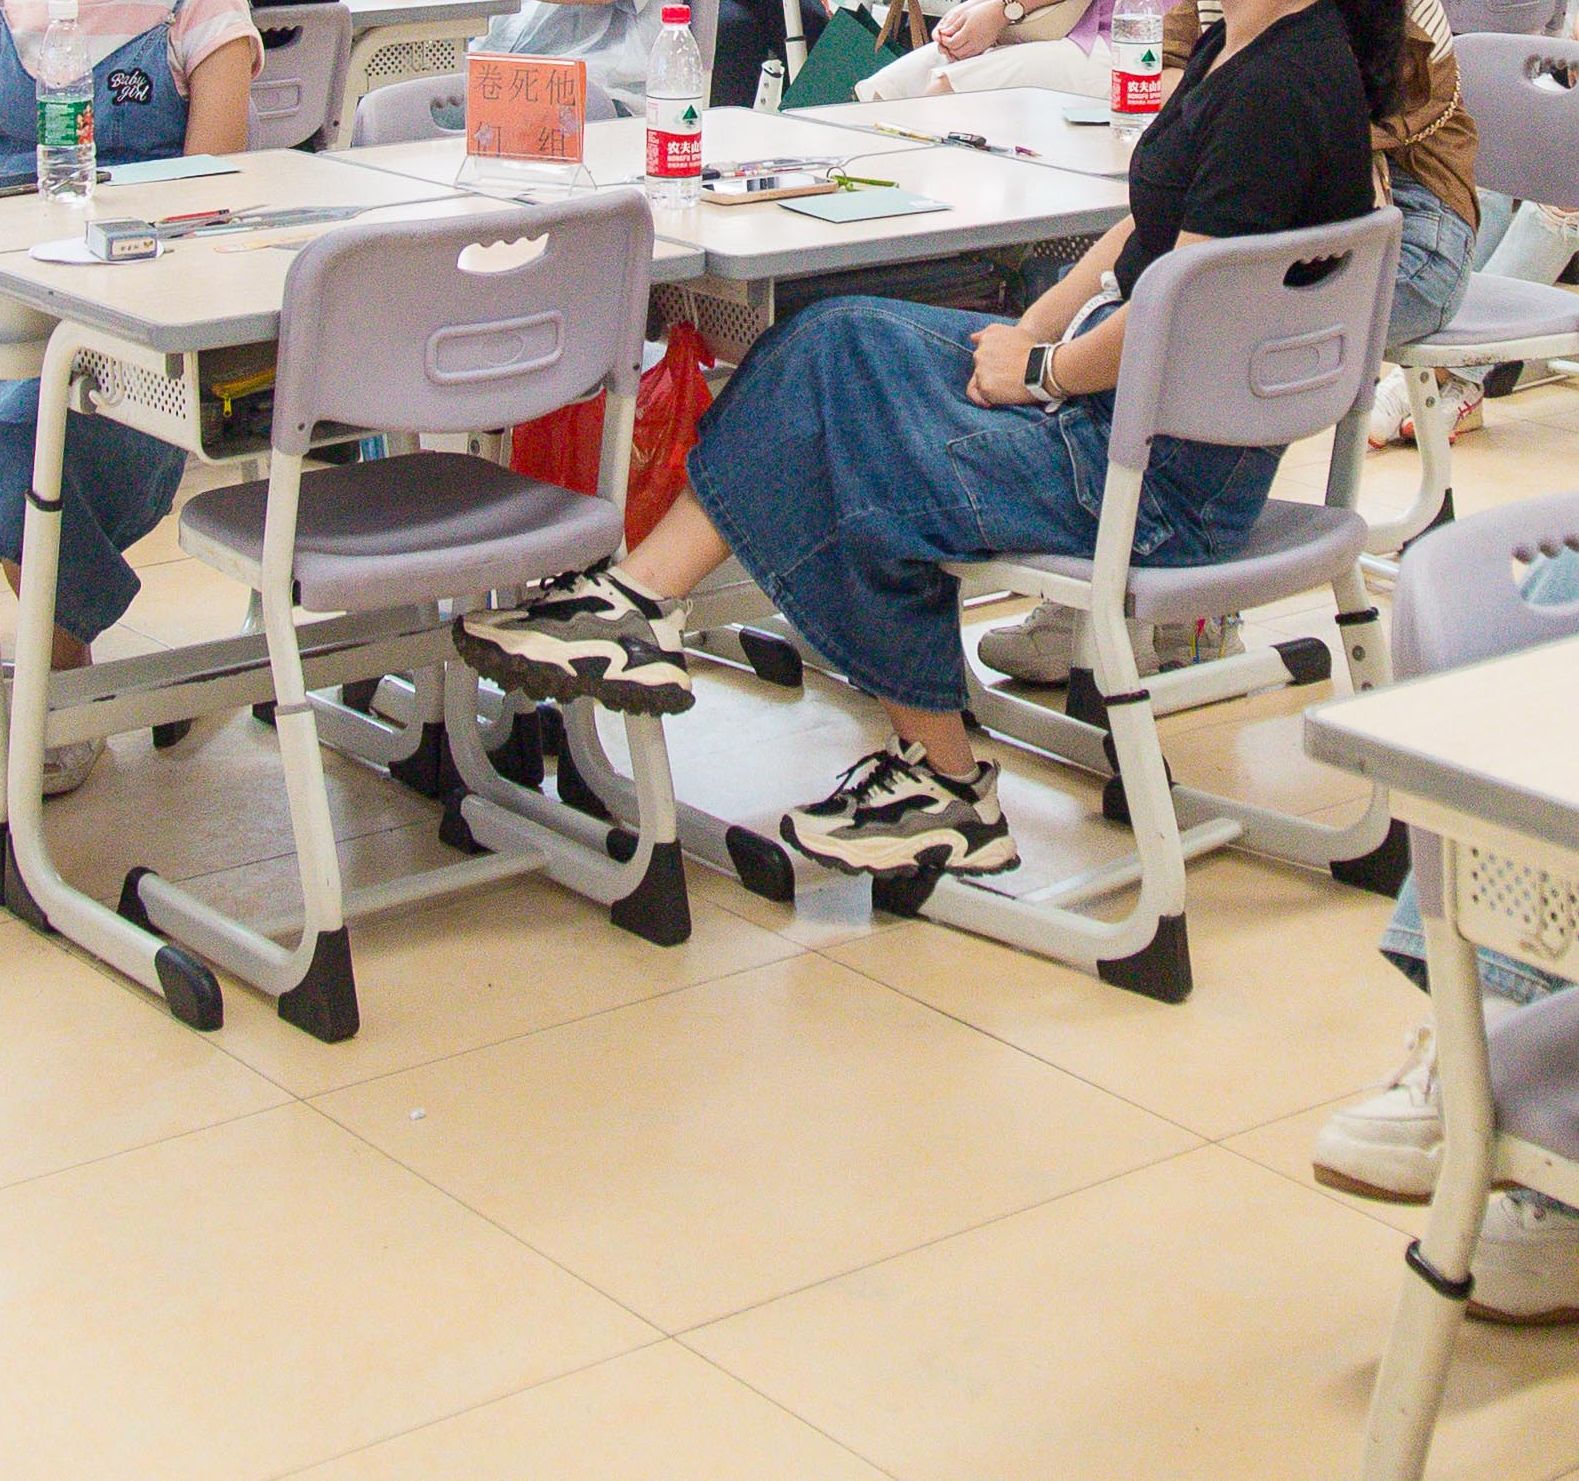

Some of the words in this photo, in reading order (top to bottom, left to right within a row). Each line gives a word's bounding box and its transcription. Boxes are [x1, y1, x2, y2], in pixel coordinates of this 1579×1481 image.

[111, 71, 147, 89] Baby
[473, 64, 577, 107] 卷死他
[1128, 80, 1160, 93] 农夫山
[117, 85, 150, 102] girl
[668, 139, 701, 155] 农夫山
